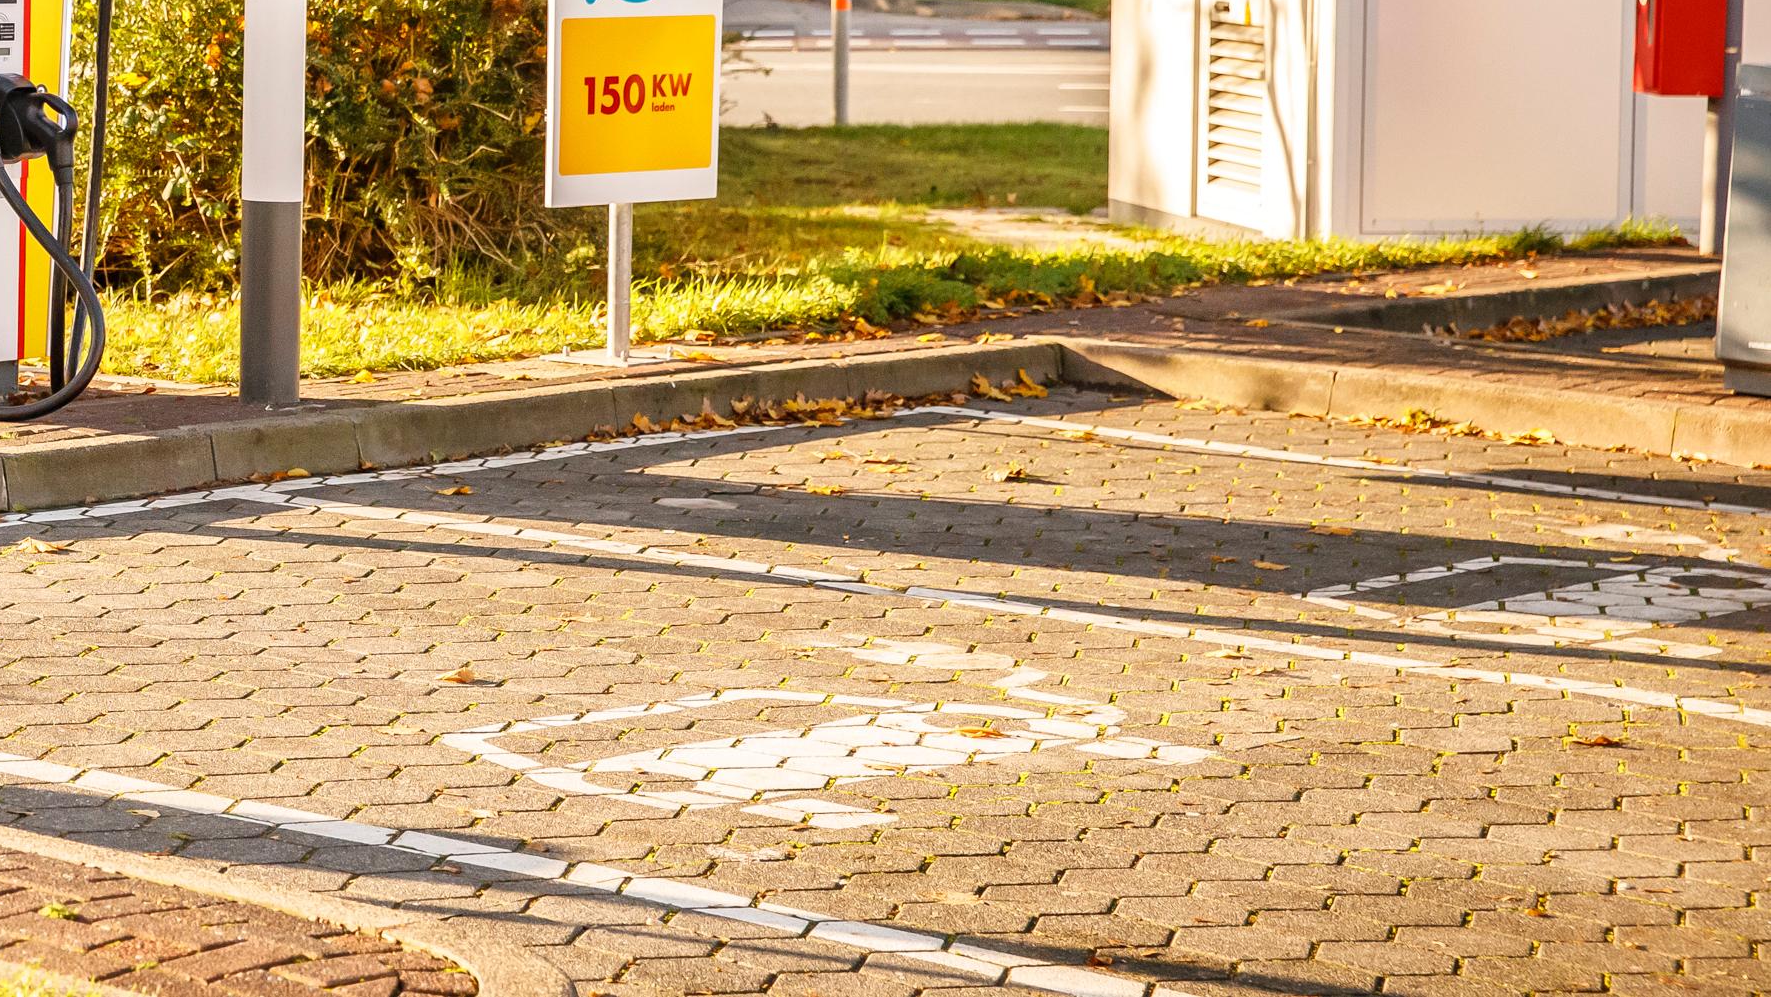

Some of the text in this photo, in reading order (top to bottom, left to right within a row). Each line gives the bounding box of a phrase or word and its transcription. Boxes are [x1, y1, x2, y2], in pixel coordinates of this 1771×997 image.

[584, 72, 693, 116] 150 KW
[651, 101, 675, 113] laden
